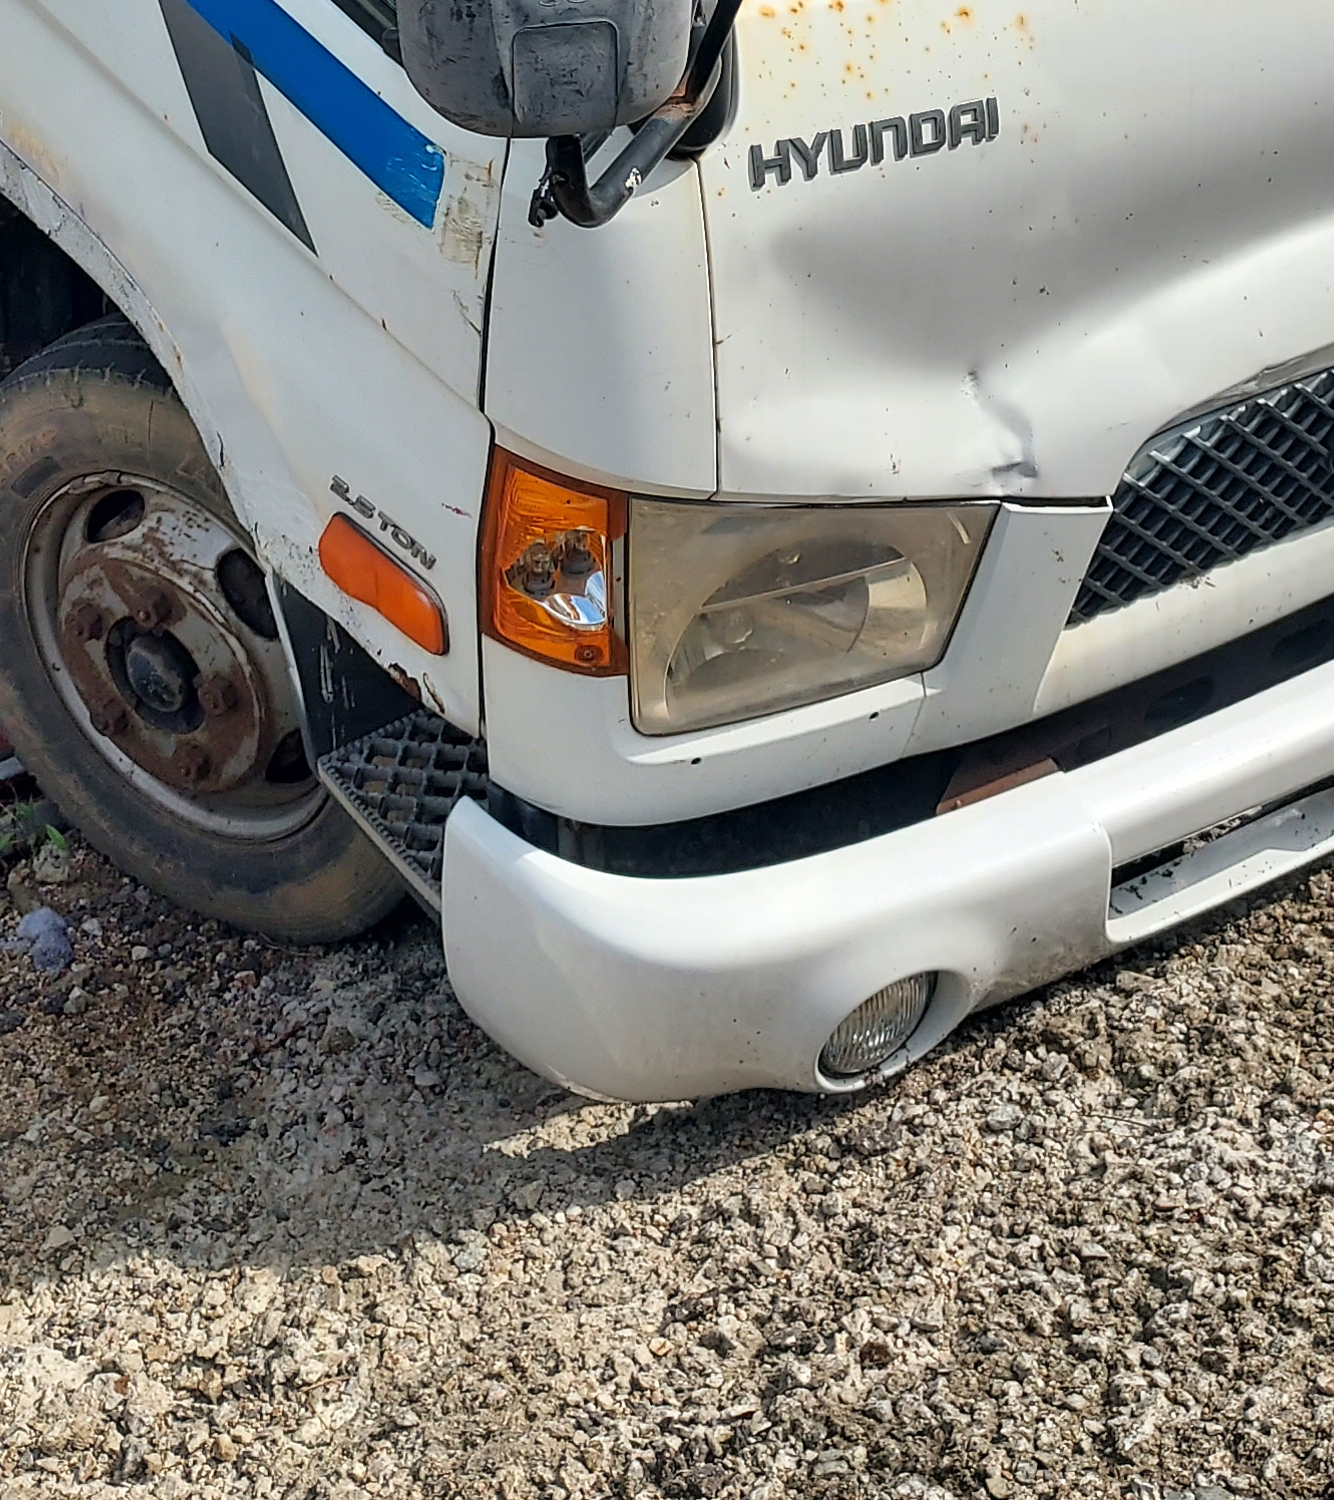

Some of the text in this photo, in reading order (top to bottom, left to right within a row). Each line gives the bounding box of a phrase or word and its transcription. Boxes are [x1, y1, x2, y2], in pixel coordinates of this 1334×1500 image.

[748, 96, 1000, 192] HYUNDAI
[329, 474, 437, 570] 2.5 TON
